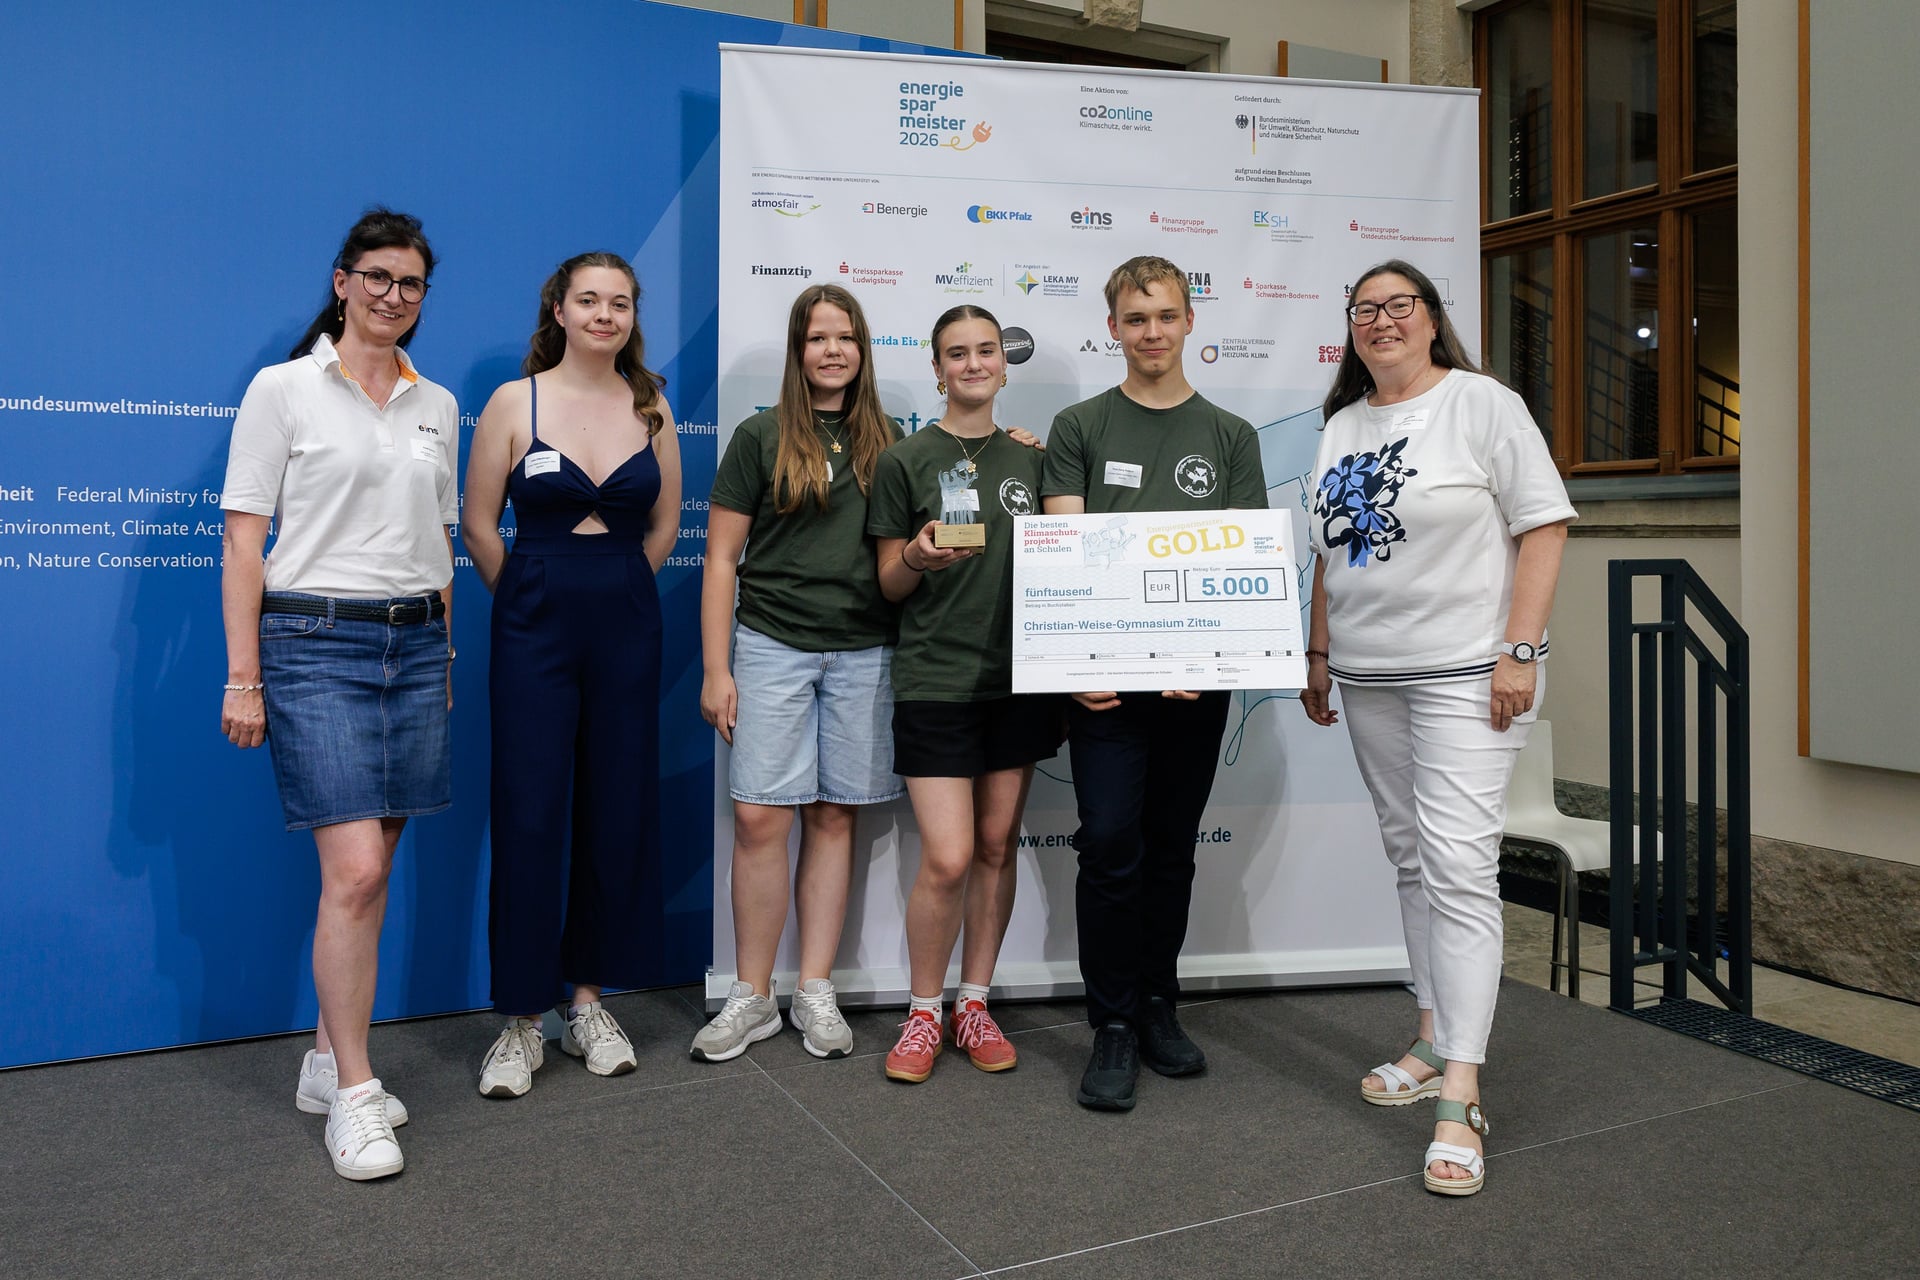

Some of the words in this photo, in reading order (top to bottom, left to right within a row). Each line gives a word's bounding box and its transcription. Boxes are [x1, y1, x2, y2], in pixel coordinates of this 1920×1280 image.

[899, 81, 964, 100] energie
[1094, 86, 1115, 94] Aktion
[1234, 95, 1262, 103] Gefördert
[1262, 96, 1282, 104] durch:
[899, 98, 937, 115] spar
[1080, 105, 1153, 121] co2online
[899, 113, 966, 131] meister
[1259, 116, 1311, 125] Bundesministerium
[1080, 121, 1120, 131] Klimaschutz,
[1121, 123, 1133, 131] der
[1134, 124, 1153, 132] wirkt.
[1259, 123, 1267, 131] für
[1268, 124, 1291, 132] Umwelt,
[1292, 125, 1326, 134] Klimaschutz,
[1327, 127, 1360, 135] Naturschutz
[899, 131, 939, 147] 2026
[1294, 133, 1322, 141] Sicherheit
[1234, 168, 1261, 176] aufgrund
[1277, 169, 1311, 177] Beschlusses
[1276, 177, 1312, 186] Bundestages
[751, 198, 799, 209] atmosfair
[877, 203, 928, 218] Benergie
[986, 210, 1008, 220] BKK
[1009, 211, 1032, 221] Pfalz
[1070, 206, 1113, 225] eins
[1161, 217, 1205, 226] Finanzgruppe
[1254, 211, 1269, 223] EK
[1161, 226, 1218, 235] Hessen-Thüringen
[1360, 226, 1400, 234] Finanzgruppe
[1360, 233, 1399, 241] Ostdeutscher
[1399, 234, 1455, 243] Sparkassenverband
[751, 265, 812, 278] Finanztip
[852, 268, 904, 277] Kreissparkasse
[852, 276, 897, 285] Ludwigsburg
[935, 274, 993, 287] MVeffizient
[1043, 275, 1064, 283] LEKA
[1065, 276, 1079, 284] MV
[1255, 283, 1287, 291] Sparkasse
[1255, 291, 1320, 300] Schwaben-Bodensee
[901, 336, 919, 346] Eis
[1221, 338, 1275, 346] ZENTRALVERBAND
[57, 486, 122, 503] Federal
[128, 488, 198, 508] Ministry
[202, 488, 224, 504] fo
[122, 520, 189, 536] Climate
[1024, 521, 1038, 529] Die
[1040, 521, 1069, 529] besten
[1146, 518, 1224, 534] Energiesparmeister
[1024, 529, 1081, 537] Klimaschutz-
[1024, 538, 1059, 547] projekte
[1147, 524, 1245, 558] GOLD
[1037, 545, 1072, 553] Schulen
[28, 552, 91, 568] Nature
[97, 552, 214, 568] Conservation
[1150, 583, 1171, 592] EUR
[1201, 576, 1269, 596] 5.000
[1025, 586, 1093, 598] fünftausend
[1024, 618, 1184, 632] Christian-Weise-Gymnasium
[1187, 617, 1221, 628] Zittau
